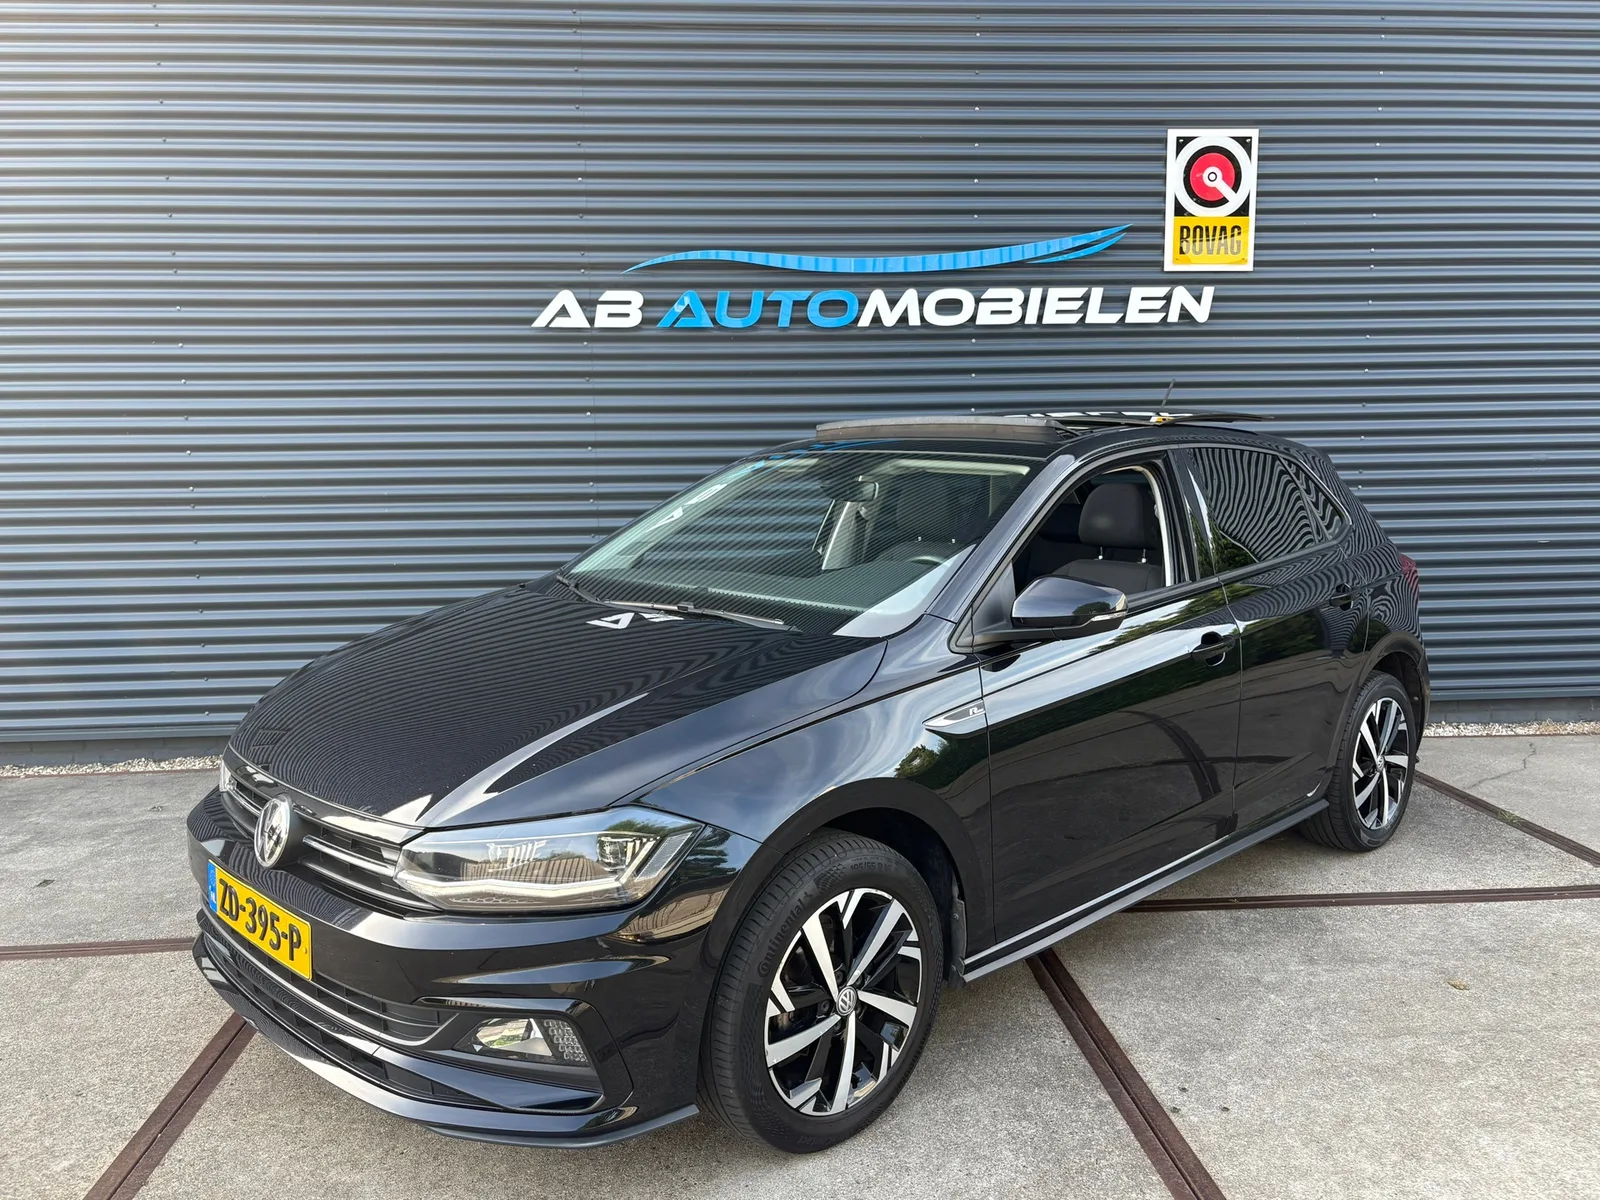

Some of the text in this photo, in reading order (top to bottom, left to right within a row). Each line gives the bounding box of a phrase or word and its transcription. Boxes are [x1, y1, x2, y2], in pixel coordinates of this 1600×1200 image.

[1179, 225, 1242, 255] BOVAG
[531, 285, 1215, 329] AB AUTOMOBIELEN
[218, 878, 303, 962] ZD-395-P
[757, 897, 805, 978] Continental
